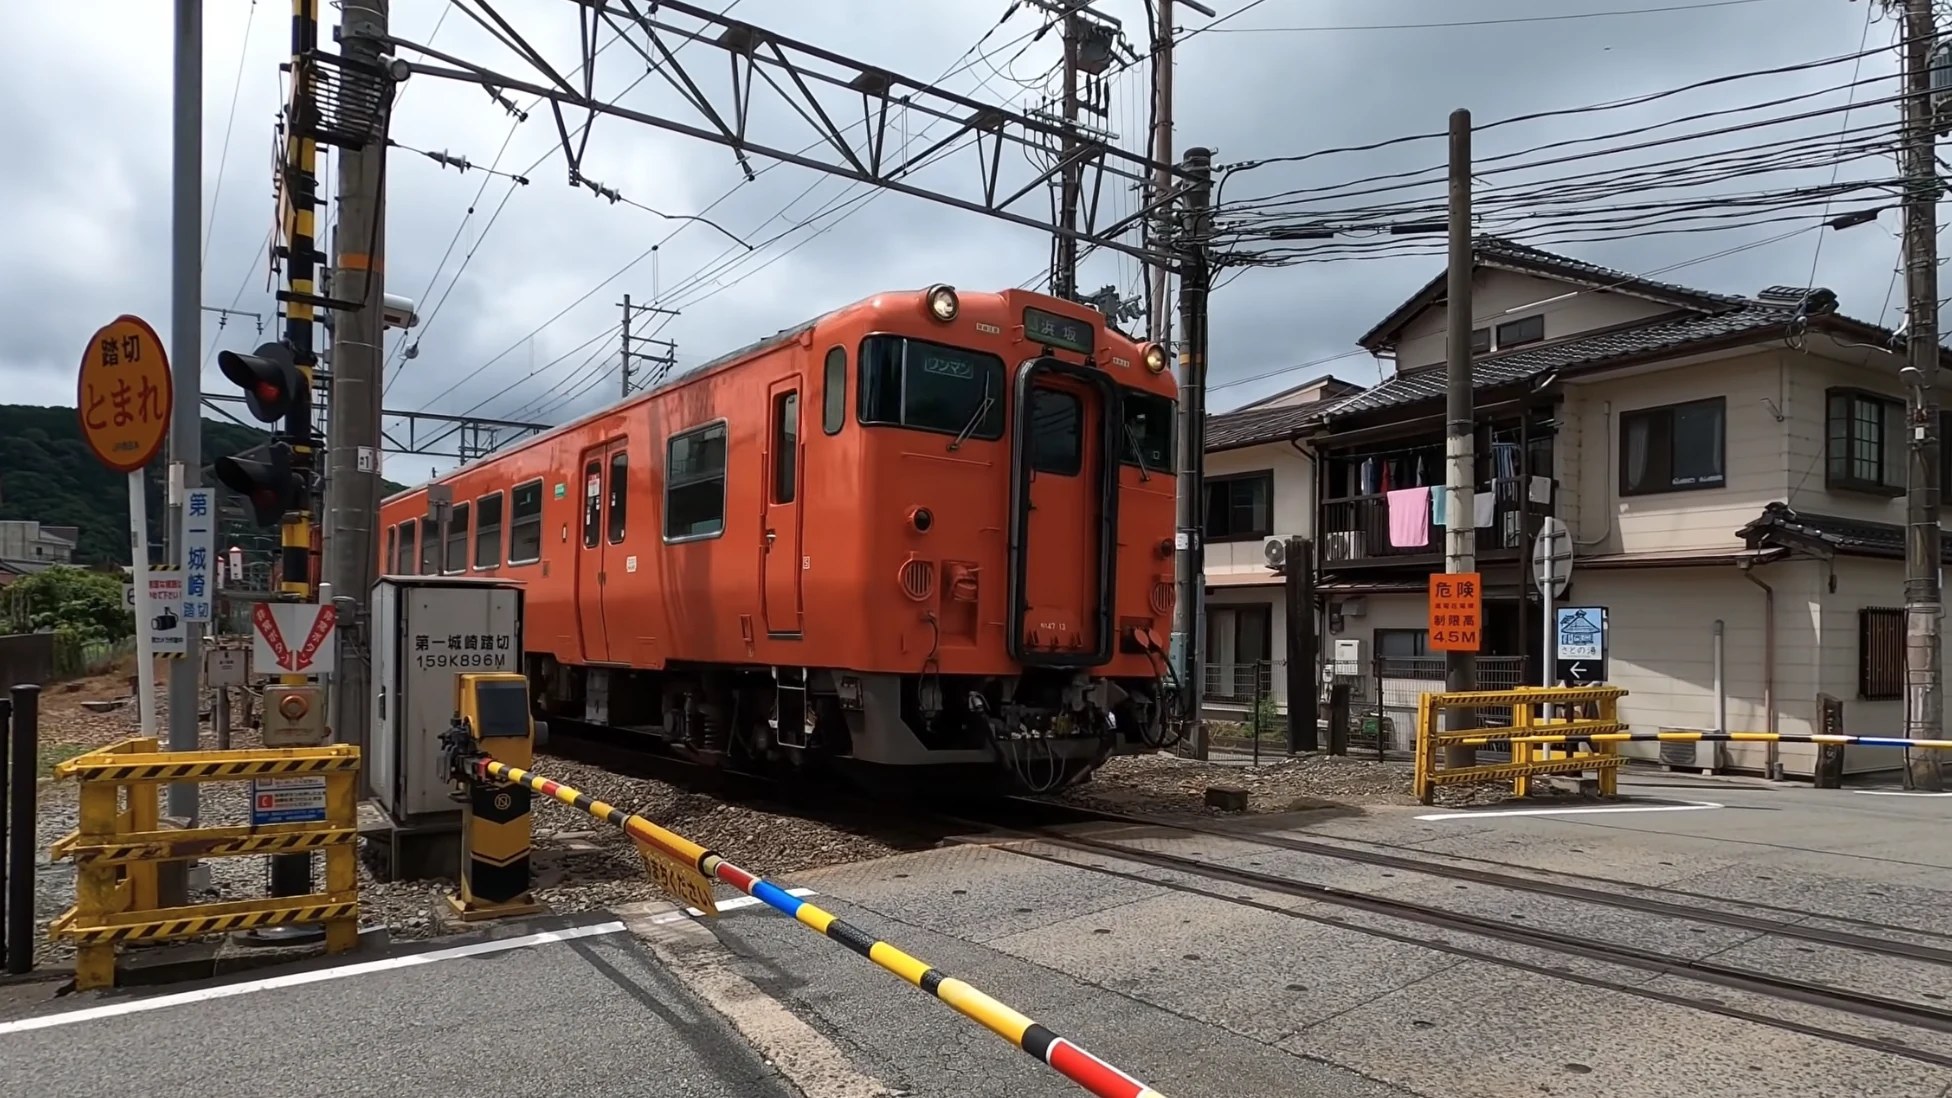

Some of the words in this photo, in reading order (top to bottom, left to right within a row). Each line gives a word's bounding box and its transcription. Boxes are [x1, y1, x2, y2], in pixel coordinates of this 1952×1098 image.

[101, 335, 140, 367] 踏切
[86, 375, 163, 430] とまれ
[188, 493, 208, 598] 第一城崎
[1435, 581, 1474, 598] 危険
[183, 602, 208, 618] 踏切
[1434, 615, 1475, 626] 制限高
[415, 634, 510, 651] 第一城崎踏切
[1433, 631, 1476, 643] 4.5M
[416, 654, 506, 668] 159K896M
